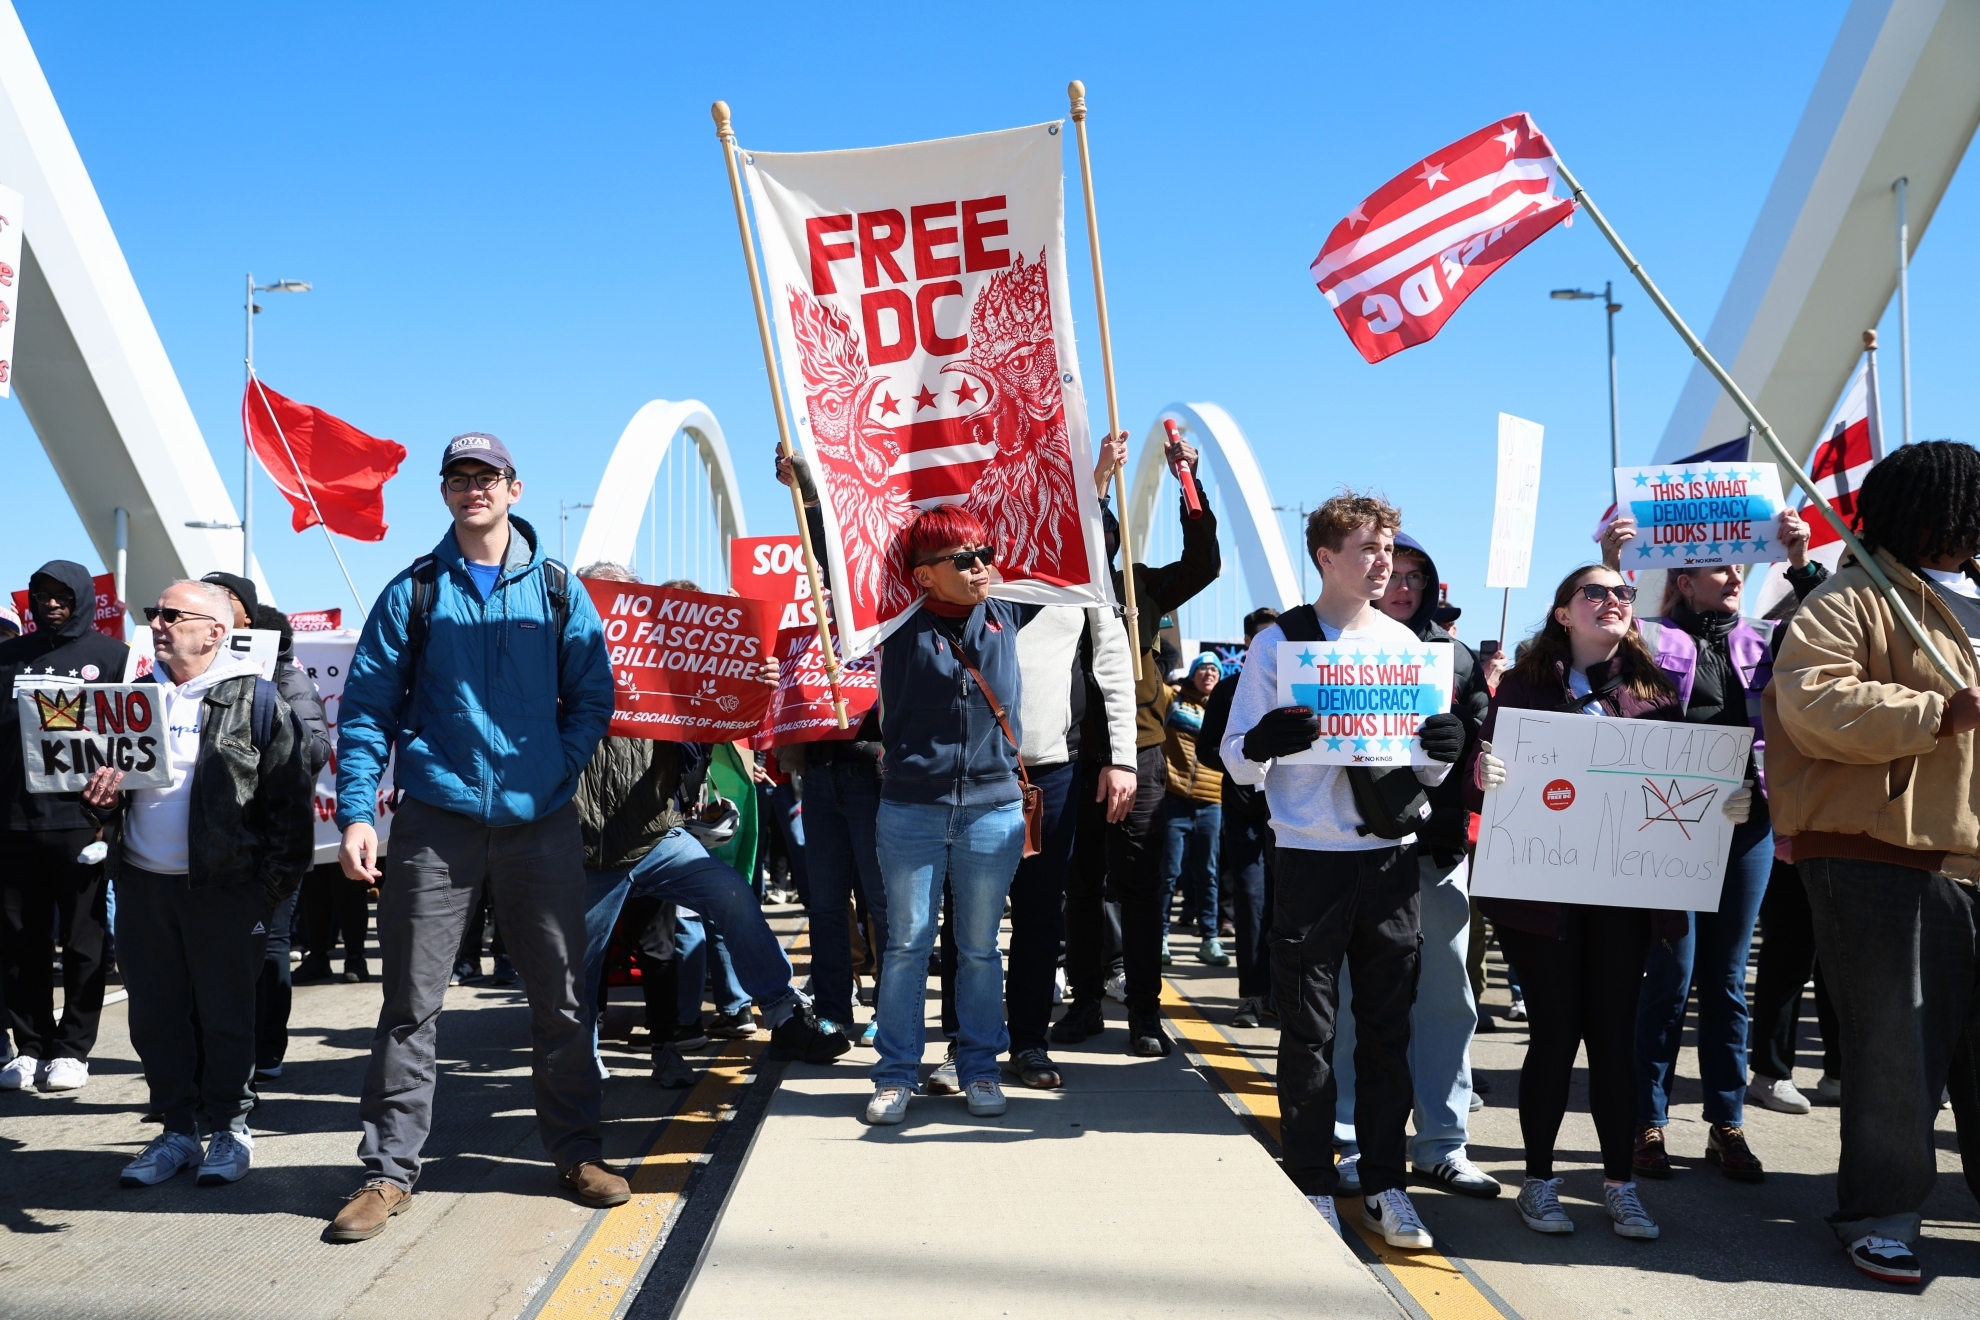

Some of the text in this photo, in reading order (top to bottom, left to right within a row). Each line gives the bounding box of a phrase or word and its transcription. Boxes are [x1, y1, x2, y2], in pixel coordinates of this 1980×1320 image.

[806, 195, 1010, 296] FREE
[860, 280, 968, 367] DC
[1650, 480, 1747, 502] THIS IS WHAT
[1653, 499, 1750, 523] DEMOCRACY
[1653, 519, 1752, 545] LOOKS LIKE
[610, 593, 743, 630] NO KINGS
[632, 622, 761, 658] FASCISTS
[788, 635, 811, 657] NO
[1317, 664, 1421, 686] THIS IS WHAT
[94, 690, 153, 734] NO
[1317, 688, 1421, 711] DEMOCRACY
[632, 711, 696, 726] SOCIALISTS
[696, 717, 712, 727] OF
[712, 719, 760, 730] AMERICA
[1317, 713, 1420, 736] LOOKS LIKE
[41, 736, 157, 776] KINGS
[1515, 717, 1751, 776] First DICTATOR
[1487, 786, 1722, 881] Kinda Nervous!
